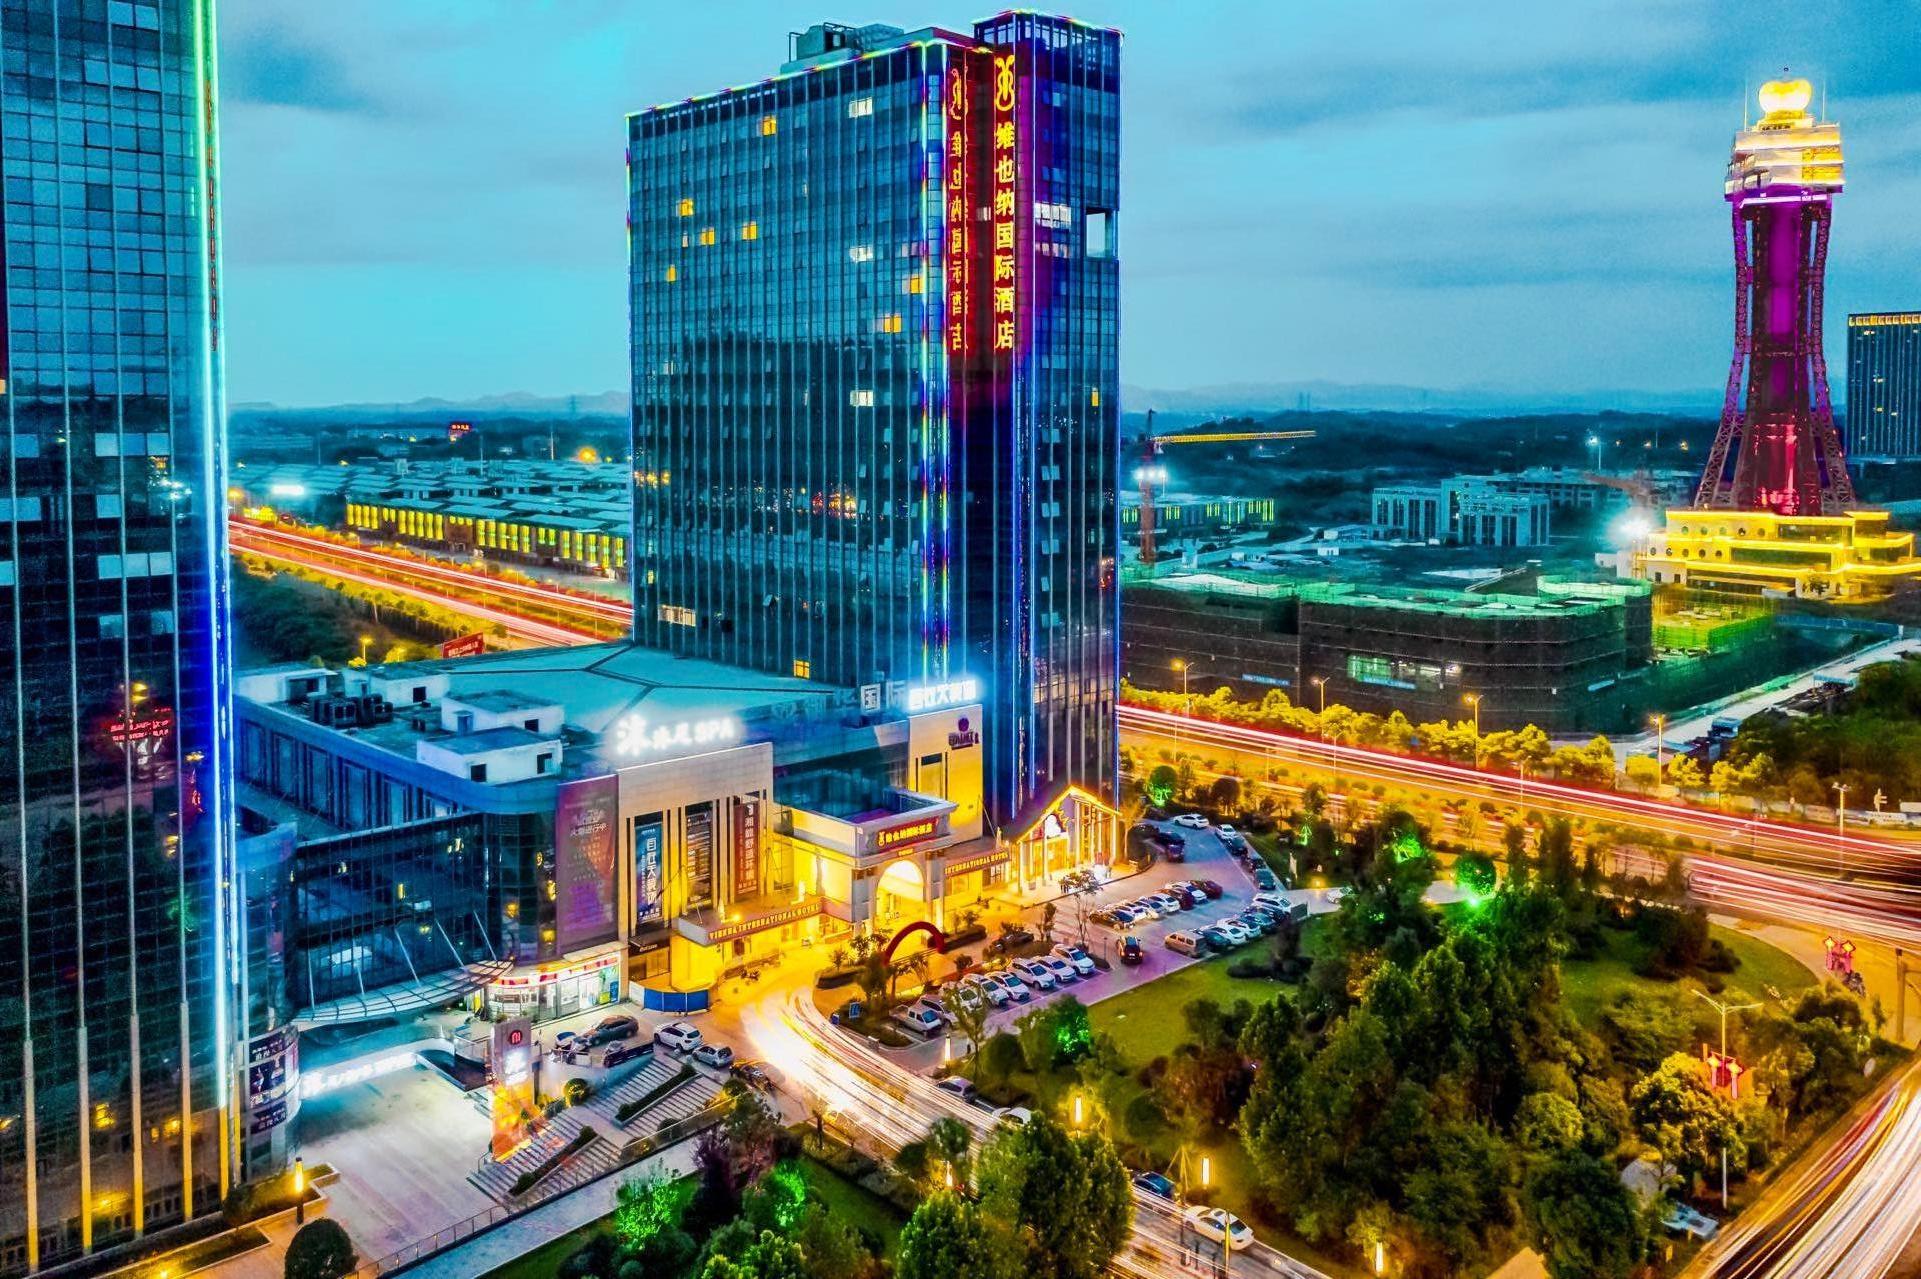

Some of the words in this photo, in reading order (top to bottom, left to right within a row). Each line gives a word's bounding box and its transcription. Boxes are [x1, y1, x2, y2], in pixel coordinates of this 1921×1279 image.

[994, 122, 1015, 349] 维也纳国际酒店
[944, 856, 990, 875] INTERNATIONAL
[709, 926, 738, 940] VIENNA
[738, 910, 796, 933] INTERNATIONAL
[796, 903, 819, 916] HOTEL
